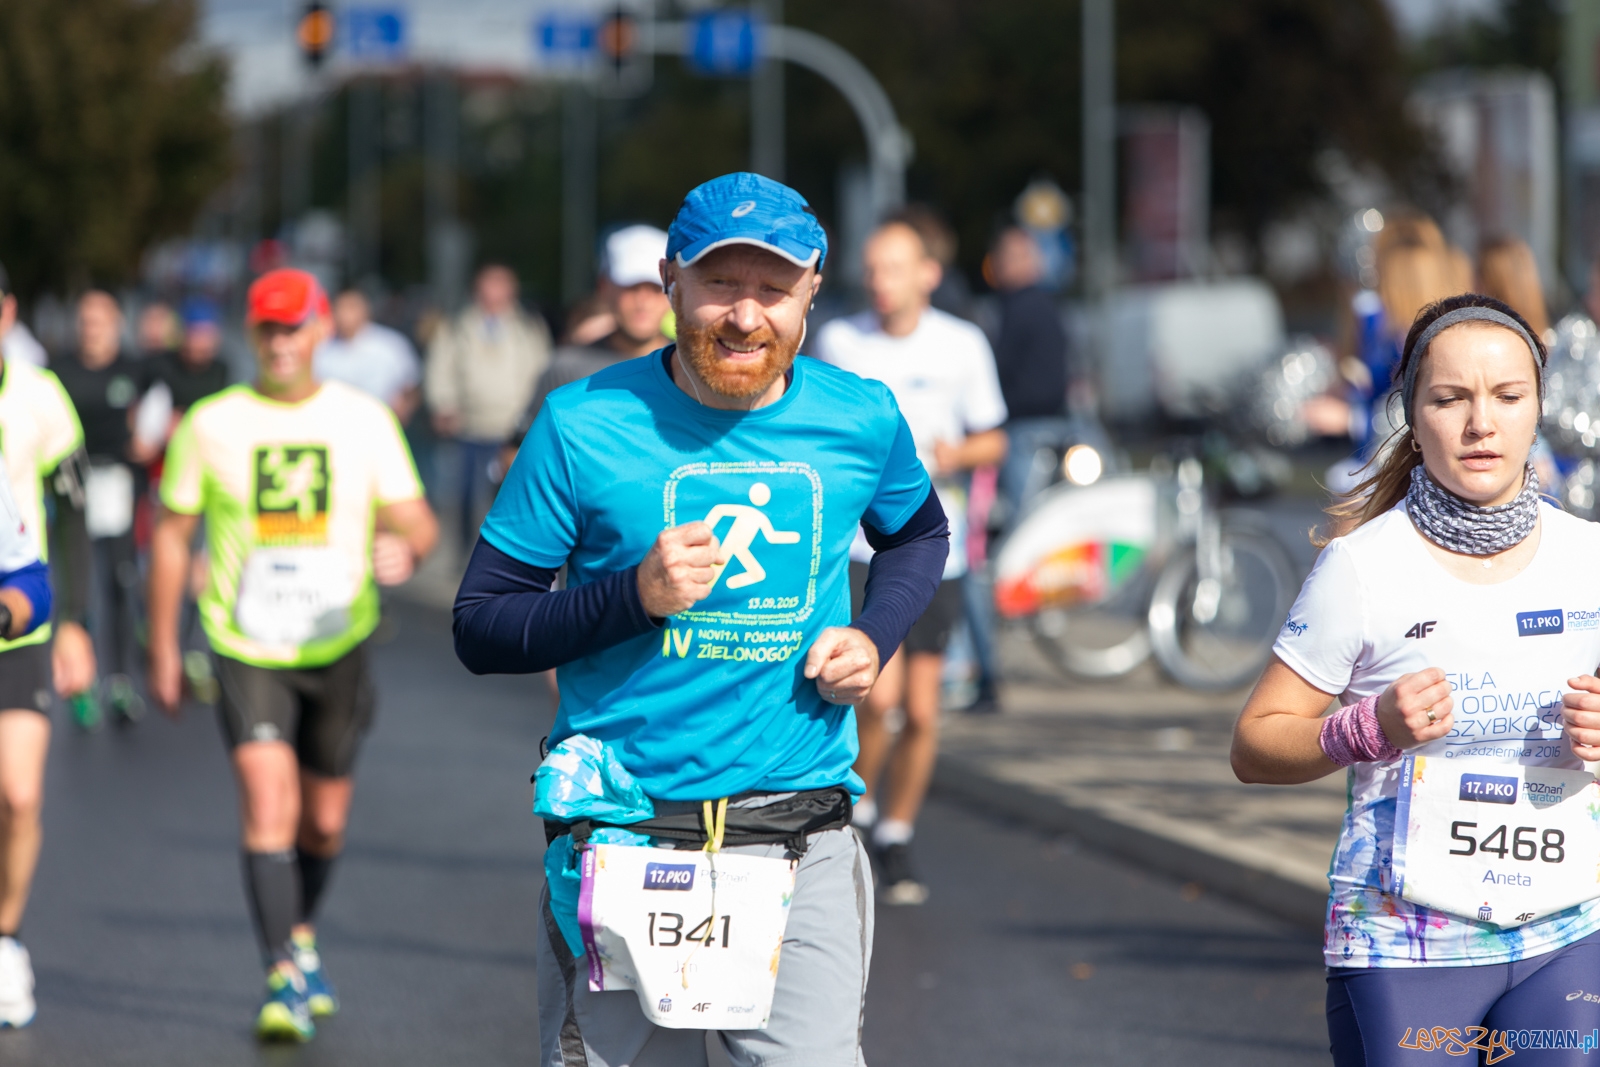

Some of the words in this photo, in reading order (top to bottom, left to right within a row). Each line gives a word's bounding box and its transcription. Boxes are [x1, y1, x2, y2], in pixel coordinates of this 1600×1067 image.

[1567, 619, 1600, 628] maraton
[662, 627, 693, 658] IV
[1446, 671, 1497, 692] SIŁA
[1456, 745, 1532, 758] października
[1534, 745, 1562, 758] 2016
[1521, 792, 1562, 803] maraton
[1449, 820, 1565, 863] 5468
[1482, 869, 1532, 887] Aneta
[647, 911, 731, 949] 1341
